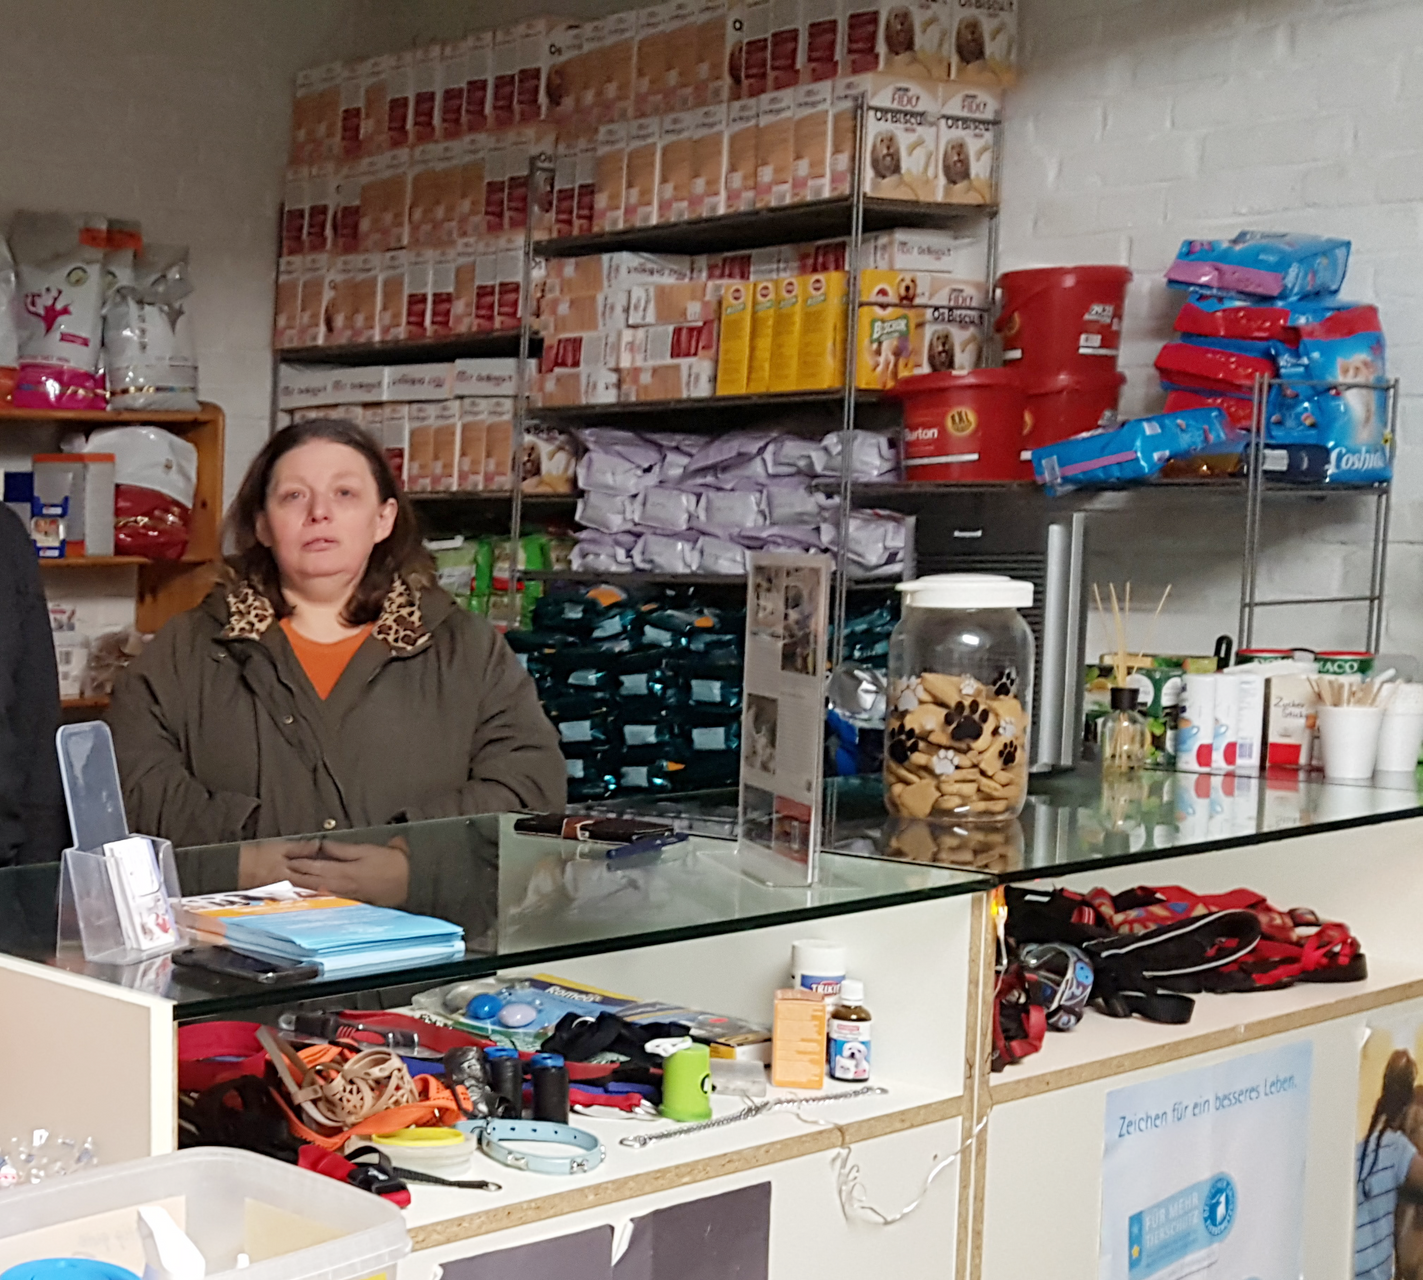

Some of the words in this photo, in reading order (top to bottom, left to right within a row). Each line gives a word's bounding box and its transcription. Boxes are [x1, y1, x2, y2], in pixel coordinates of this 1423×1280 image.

[1118, 1110, 1168, 1138] Zeichen
[1171, 1101, 1190, 1123] für
[1191, 1096, 1211, 1118] ein
[1214, 1083, 1261, 1112] besseres
